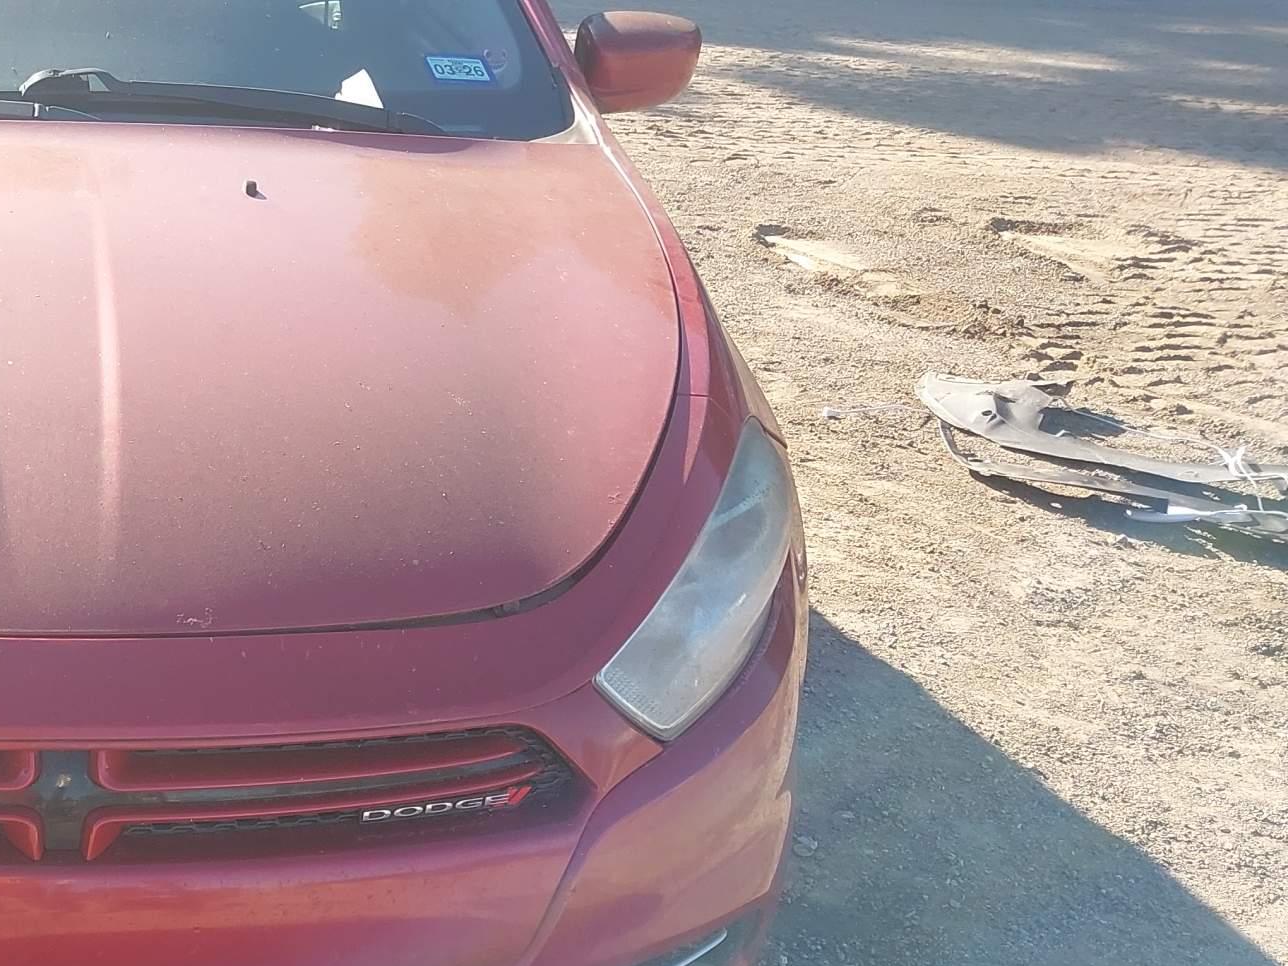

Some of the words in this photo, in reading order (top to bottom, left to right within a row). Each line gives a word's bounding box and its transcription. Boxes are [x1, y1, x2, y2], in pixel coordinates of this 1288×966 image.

[434, 63, 455, 75] 03
[462, 64, 485, 77] 26
[362, 792, 510, 822] DODGE
